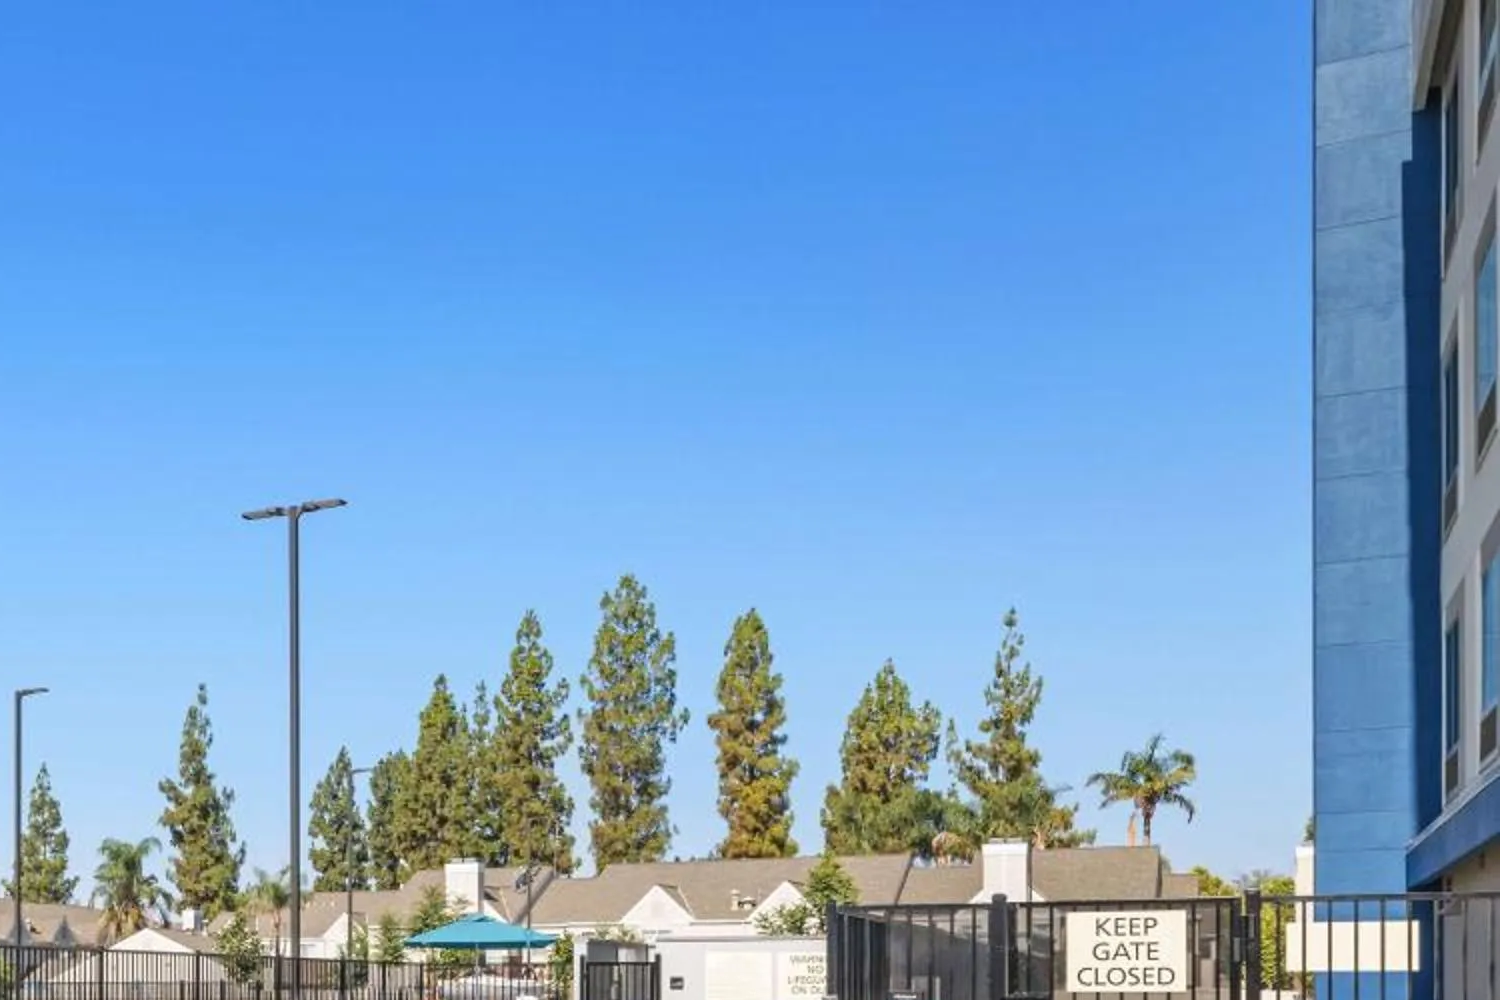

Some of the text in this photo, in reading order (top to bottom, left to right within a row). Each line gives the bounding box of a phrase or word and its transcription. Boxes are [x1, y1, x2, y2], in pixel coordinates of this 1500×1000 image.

[1095, 917, 1157, 937] KEEP
[1092, 941, 1160, 961] GATE
[807, 964, 825, 974] NO
[1077, 967, 1176, 986] CLOSED
